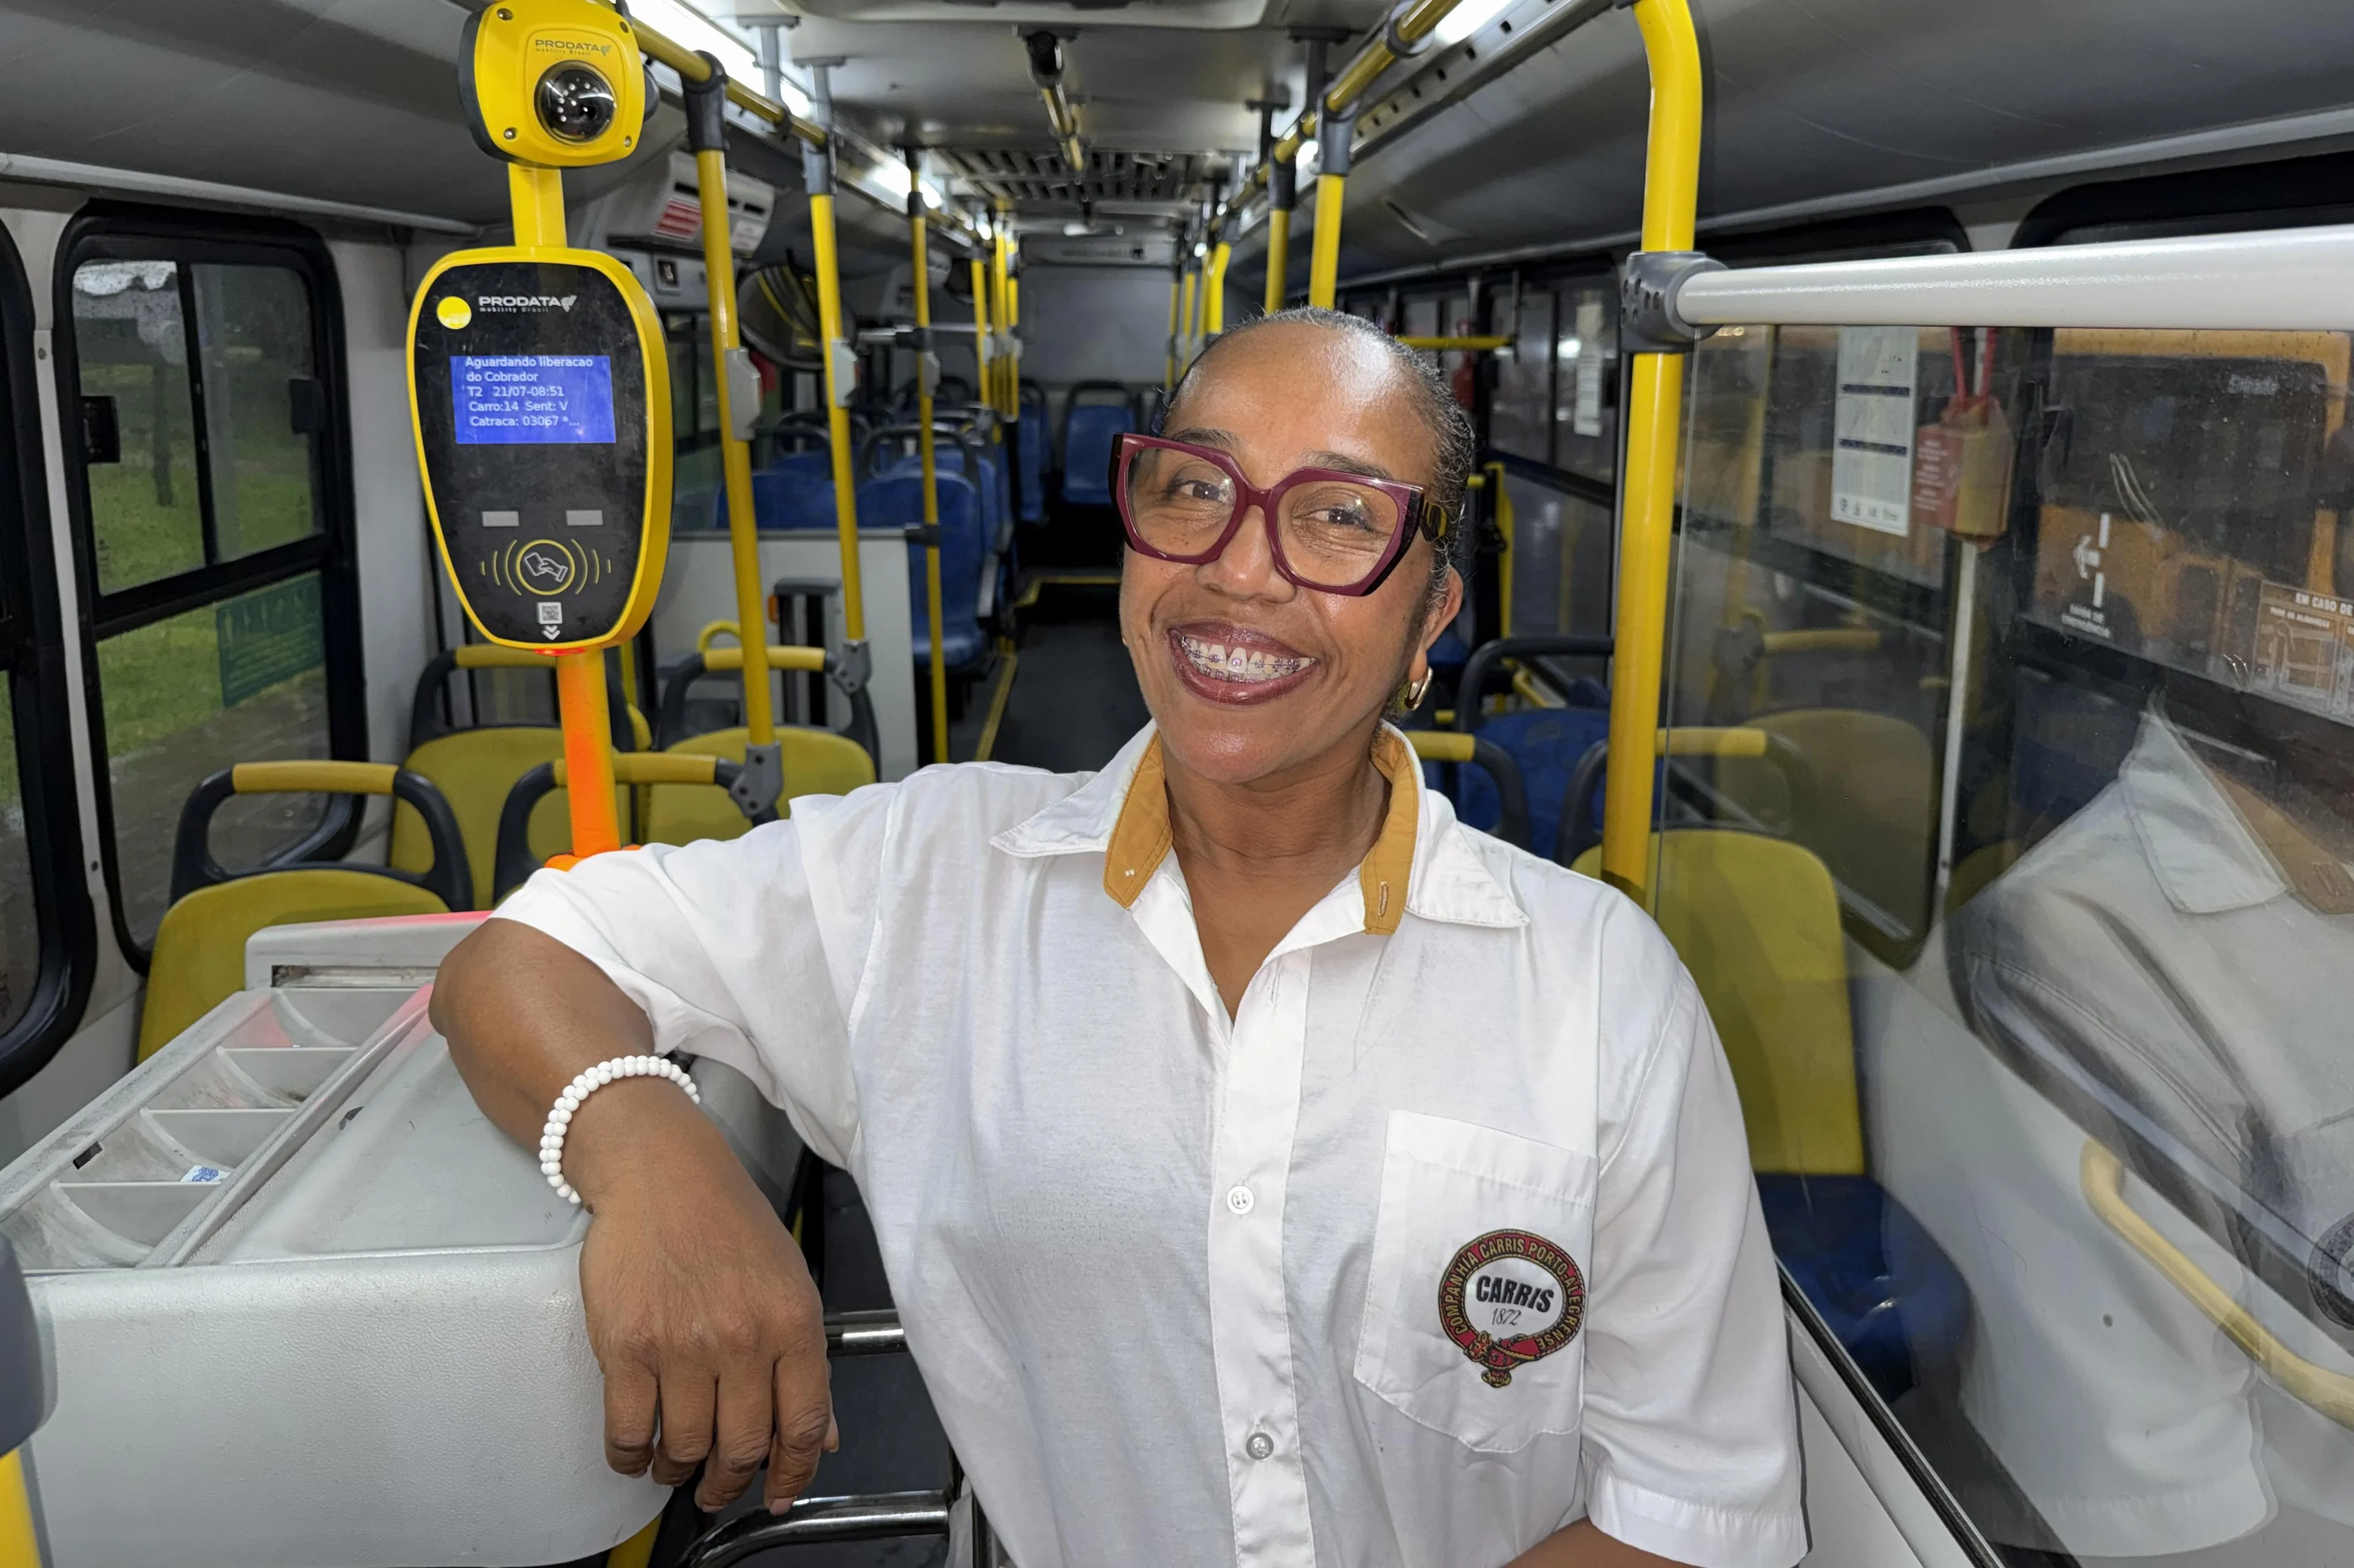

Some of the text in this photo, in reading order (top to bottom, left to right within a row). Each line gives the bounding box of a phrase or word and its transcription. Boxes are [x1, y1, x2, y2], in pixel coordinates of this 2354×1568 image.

[535, 39, 600, 52] PRODATA
[478, 295, 562, 307] PRODATA
[465, 356, 593, 369] Aguardando liberacao
[467, 371, 539, 382] do Cobrador
[467, 386, 565, 398] T2 21/07-08:51
[469, 401, 568, 411] Carro:14 Sent: V
[470, 416, 519, 426] Catraca:
[523, 416, 559, 426] 03067
[2295, 592, 2353, 616] EM CASO DE
[1444, 1237, 1581, 1350] COMPANHIA CARRIS PORTO-ALEGRENSE
[1476, 1275, 1554, 1313] CARRIS
[1491, 1307, 1522, 1326] 1872
